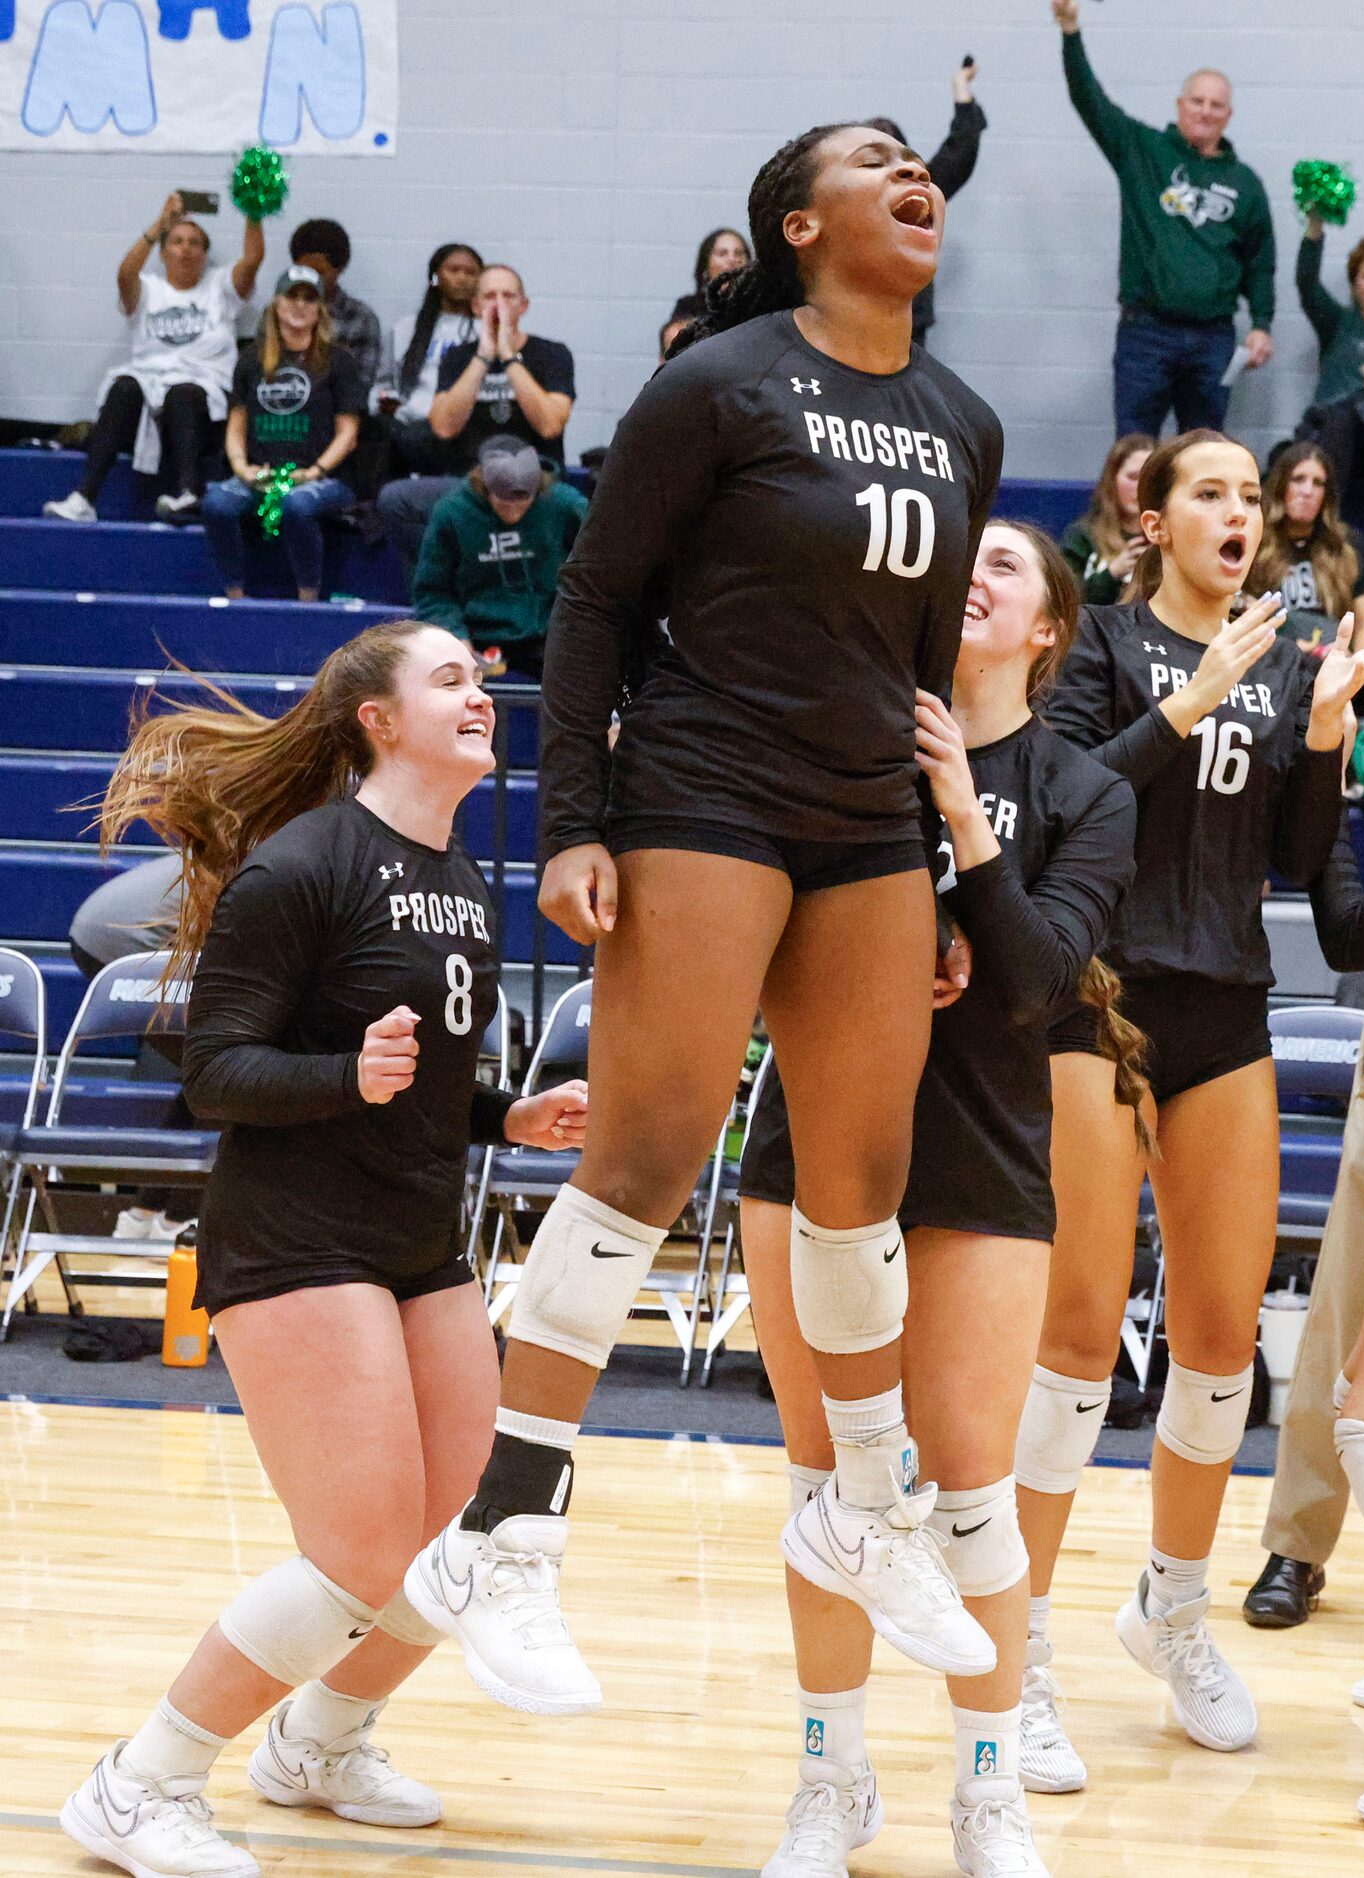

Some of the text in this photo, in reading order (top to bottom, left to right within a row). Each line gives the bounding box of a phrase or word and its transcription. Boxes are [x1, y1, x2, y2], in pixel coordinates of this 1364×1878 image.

[803, 411, 955, 483] PROSPER
[855, 482, 936, 579] 10
[1190, 716, 1253, 795] 16
[389, 892, 490, 944] PROSPER
[444, 953, 473, 1036] 8
